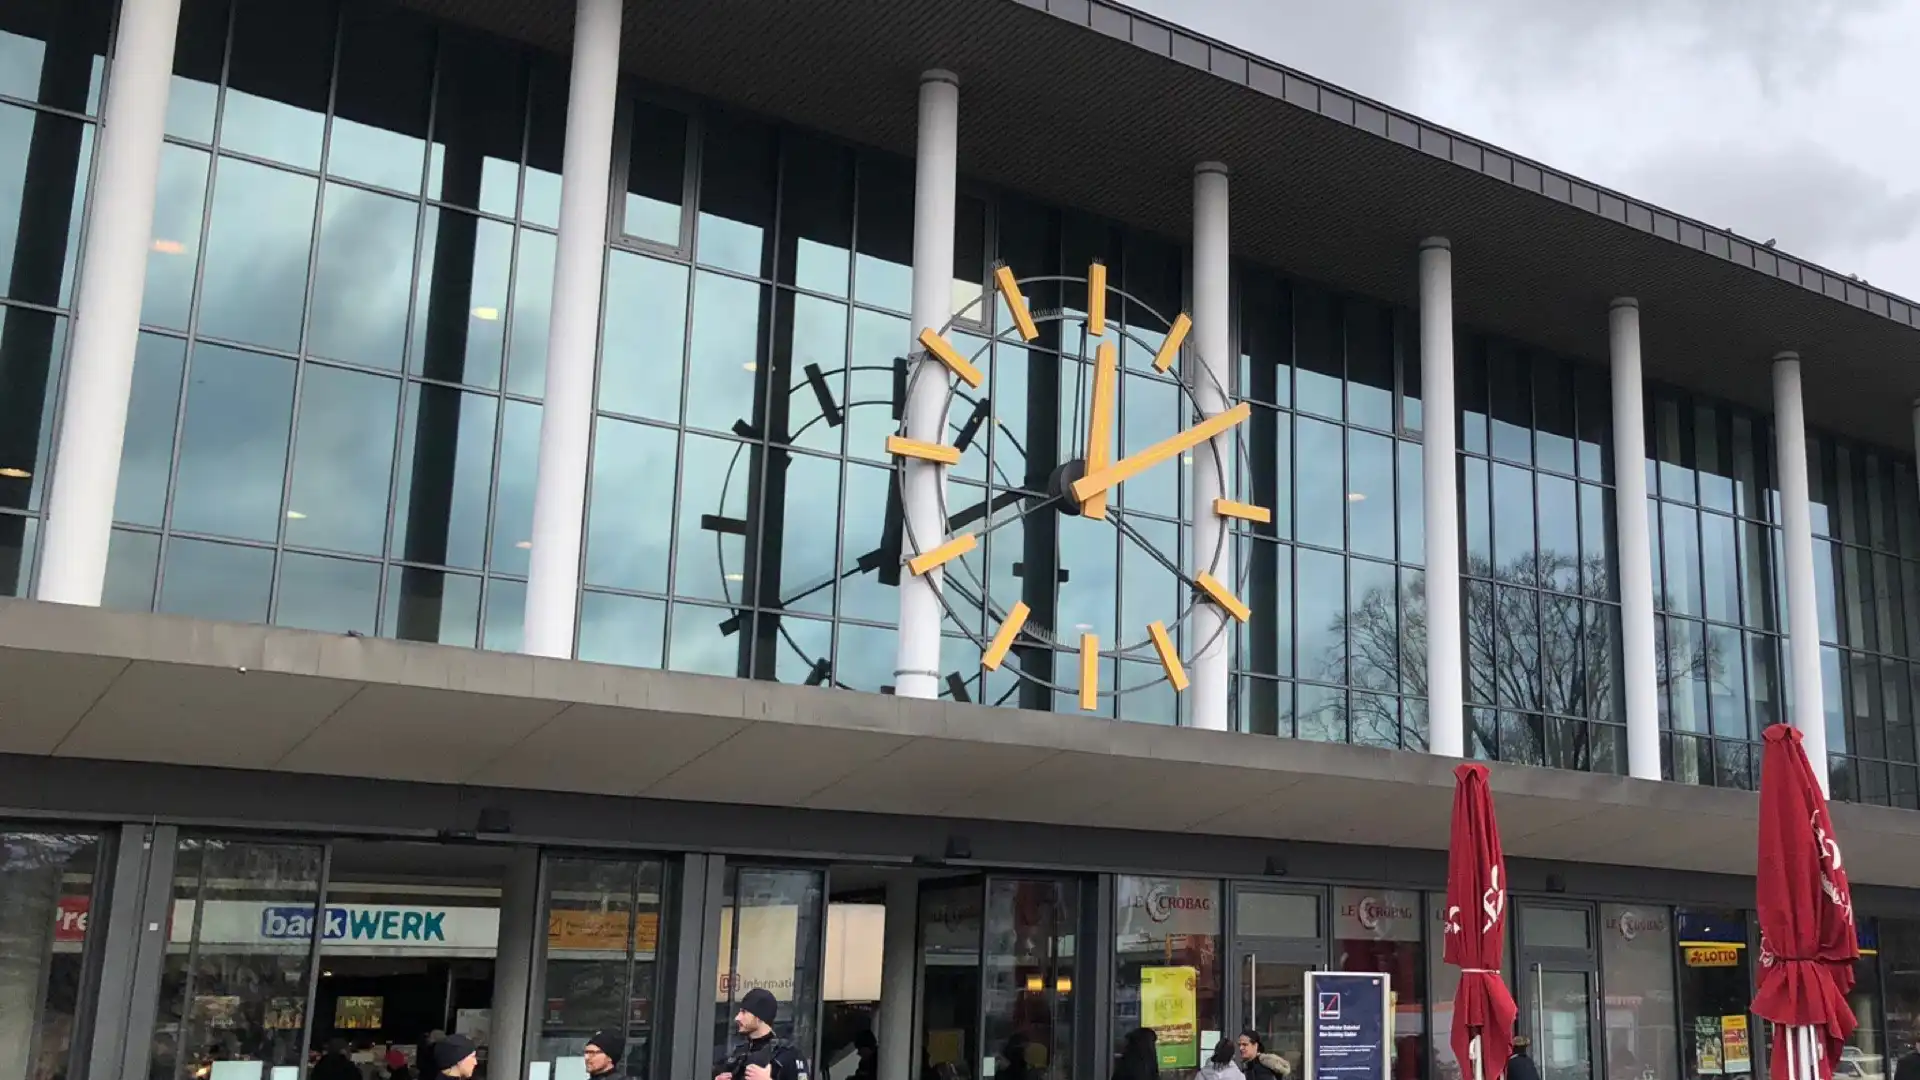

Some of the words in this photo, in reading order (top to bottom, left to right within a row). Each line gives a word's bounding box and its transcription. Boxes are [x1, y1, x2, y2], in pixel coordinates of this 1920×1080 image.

[1159, 895, 1210, 911] CROBAG
[1341, 905, 1355, 916] LE
[1704, 950, 1737, 962] LOTTO
